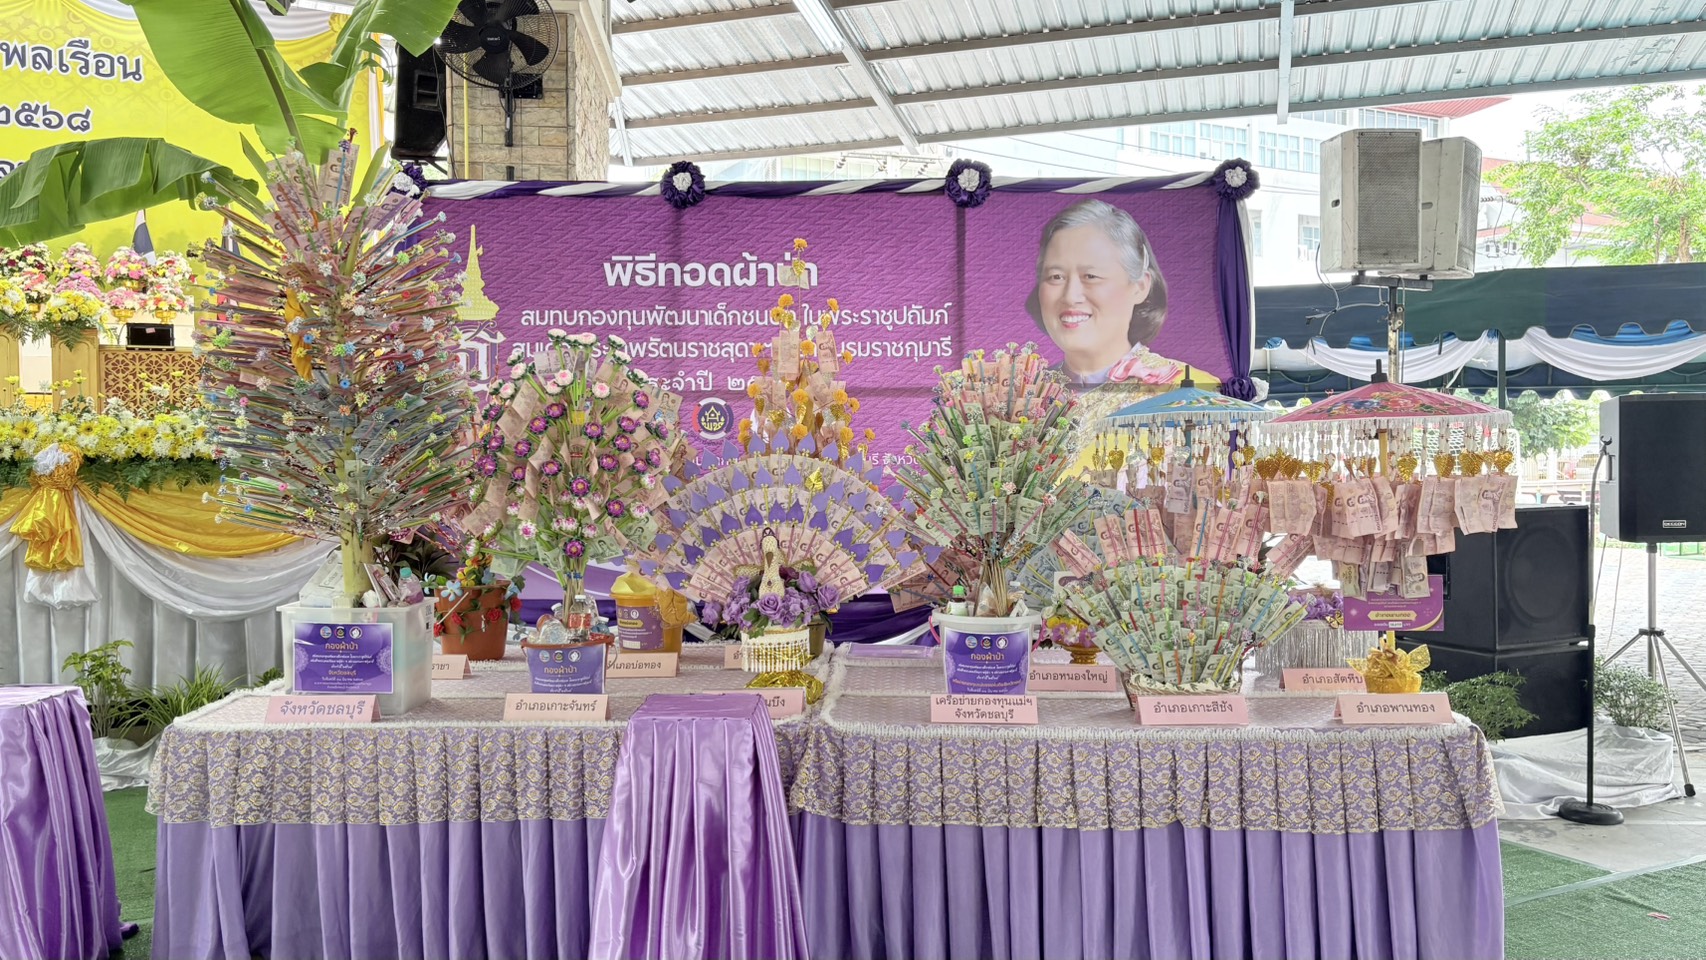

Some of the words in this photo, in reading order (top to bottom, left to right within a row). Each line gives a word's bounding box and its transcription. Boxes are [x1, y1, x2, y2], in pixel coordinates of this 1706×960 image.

[603, 252, 819, 287] พิธีทอดผ้า่า
[1029, 669, 1108, 683] อำเภอหนองใหญ่
[1302, 673, 1363, 684] อำเภอสัตหีบ
[280, 700, 366, 719] จังหวัดชลบุรี
[515, 699, 598, 712] อำเภอเกาะจันทร์
[1153, 701, 1233, 713] อำเภอเกาะสีชัง
[1356, 702, 1436, 714] อำเภอพานทอง
[954, 708, 1015, 722] จังหวัดชลบุรี
